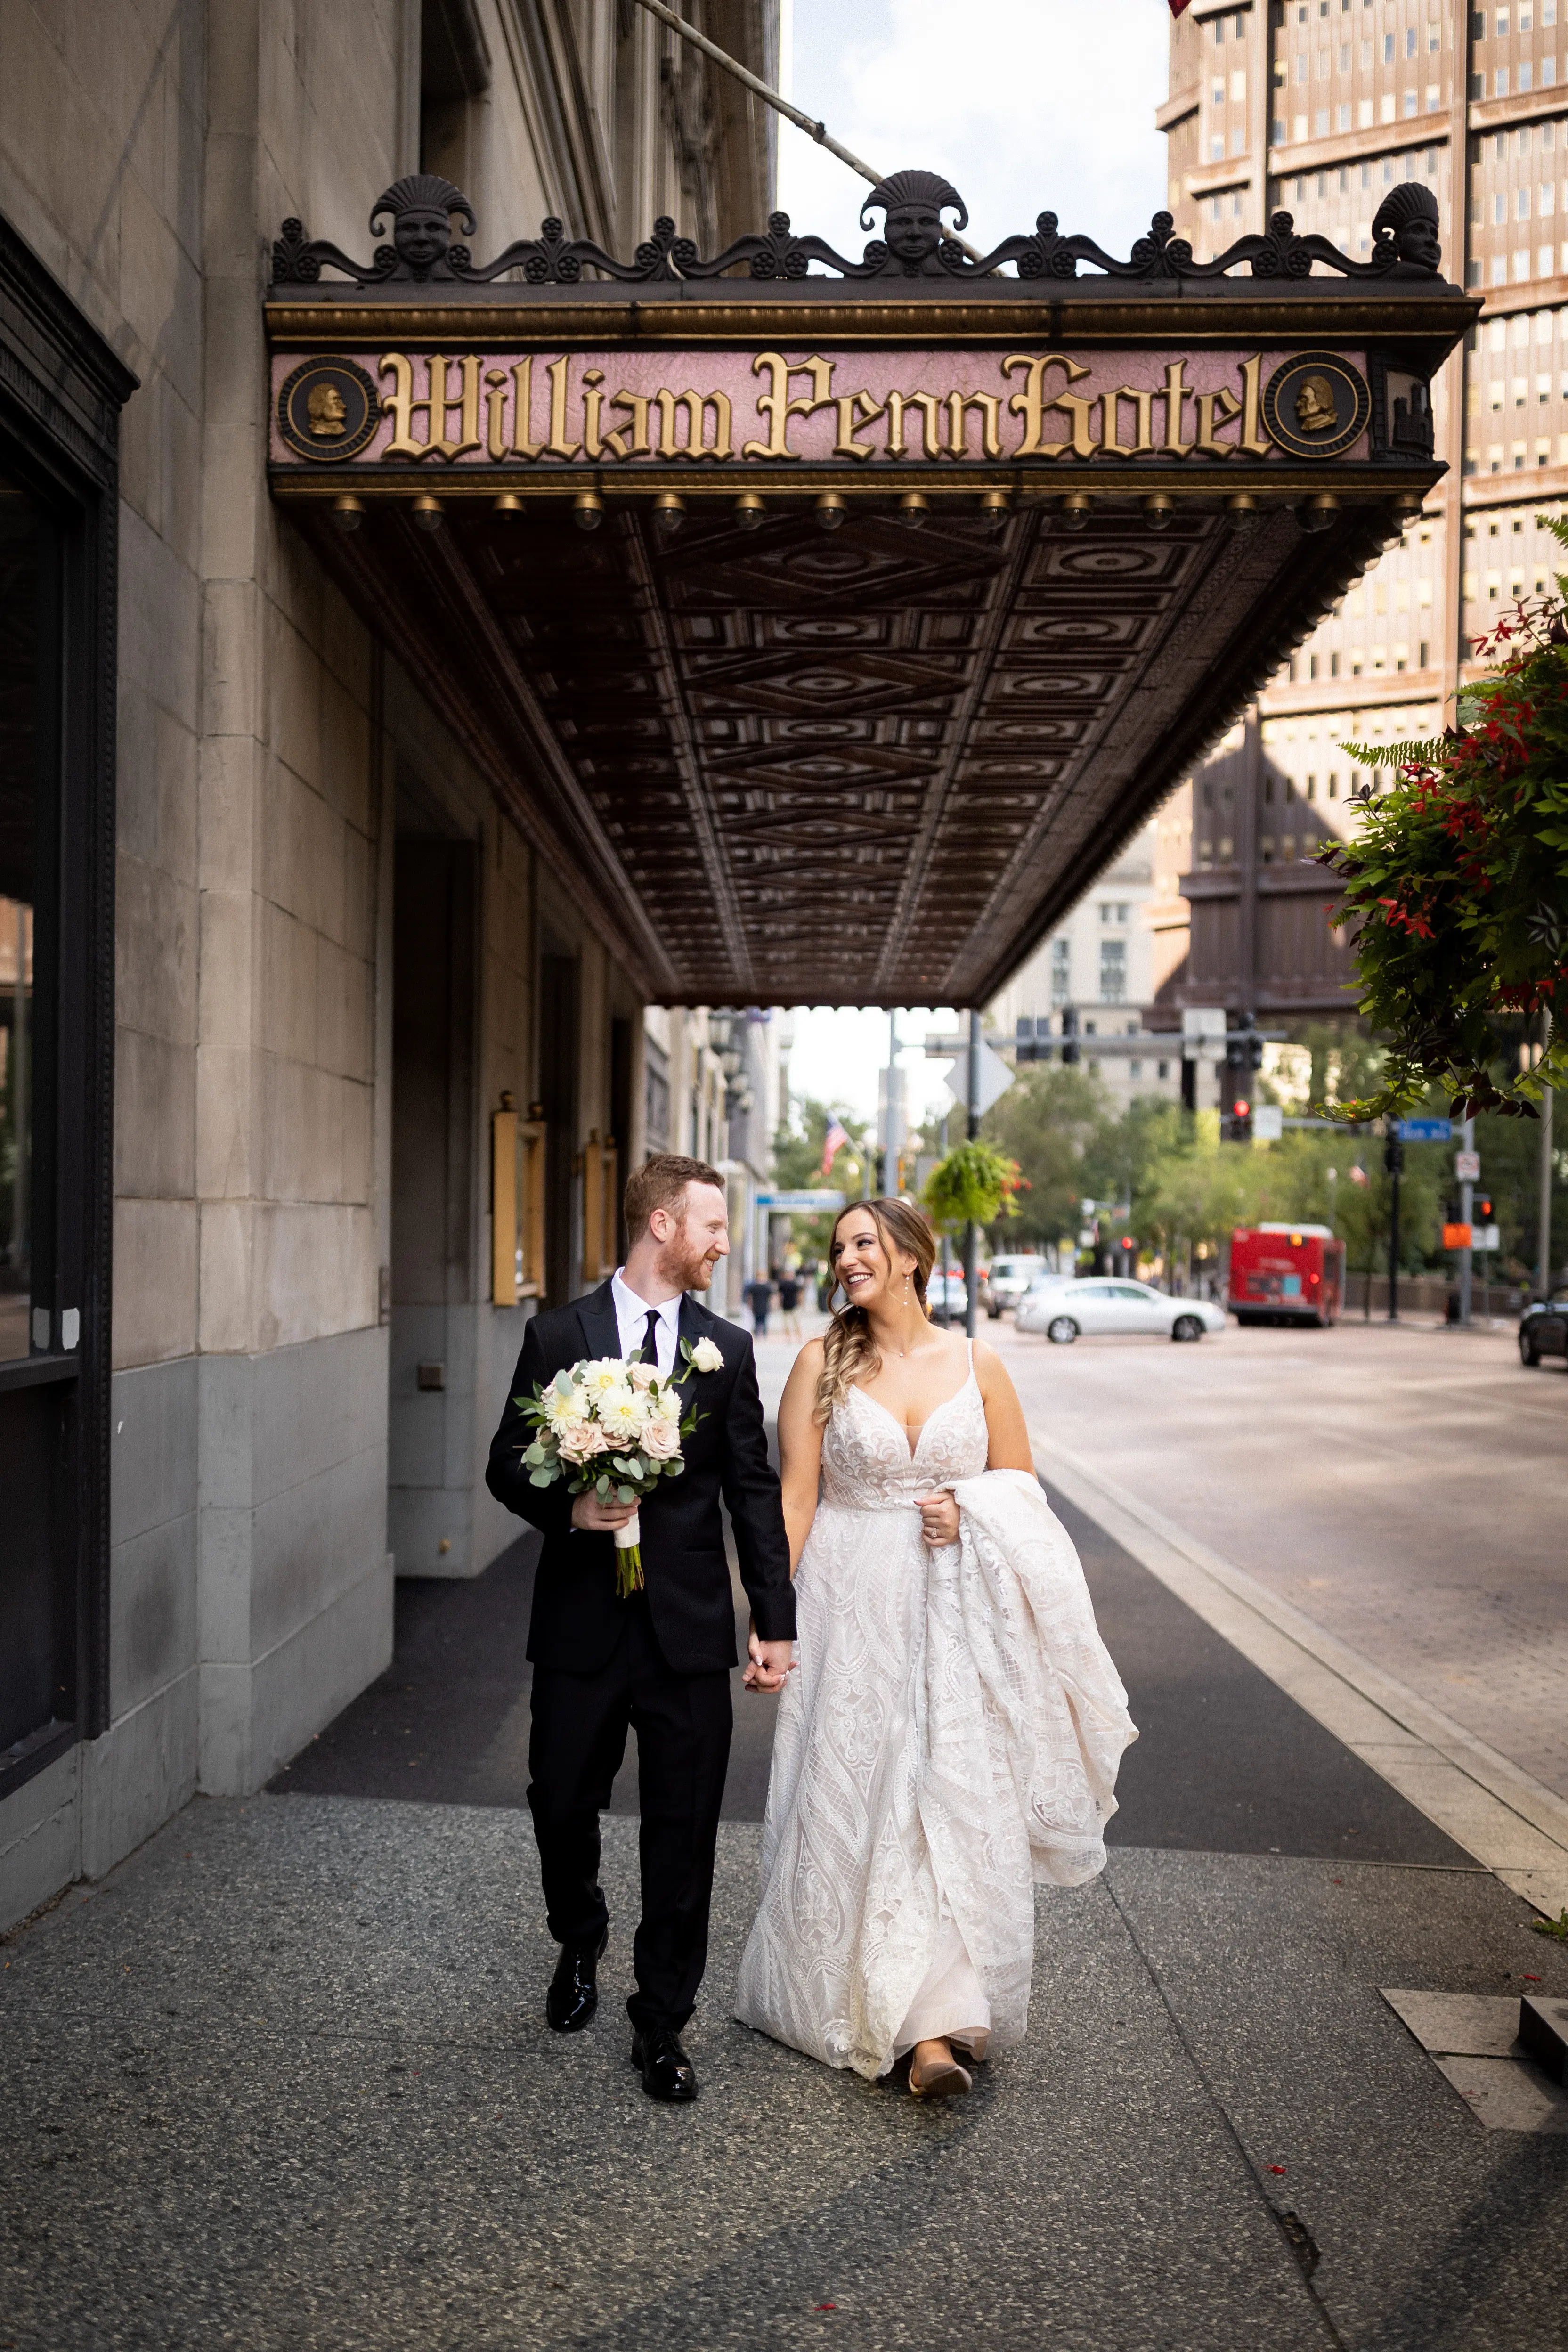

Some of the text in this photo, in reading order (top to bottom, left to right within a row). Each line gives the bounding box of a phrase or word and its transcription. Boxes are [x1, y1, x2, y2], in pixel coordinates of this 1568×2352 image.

[381, 353, 1273, 461] William Penn Hotel
